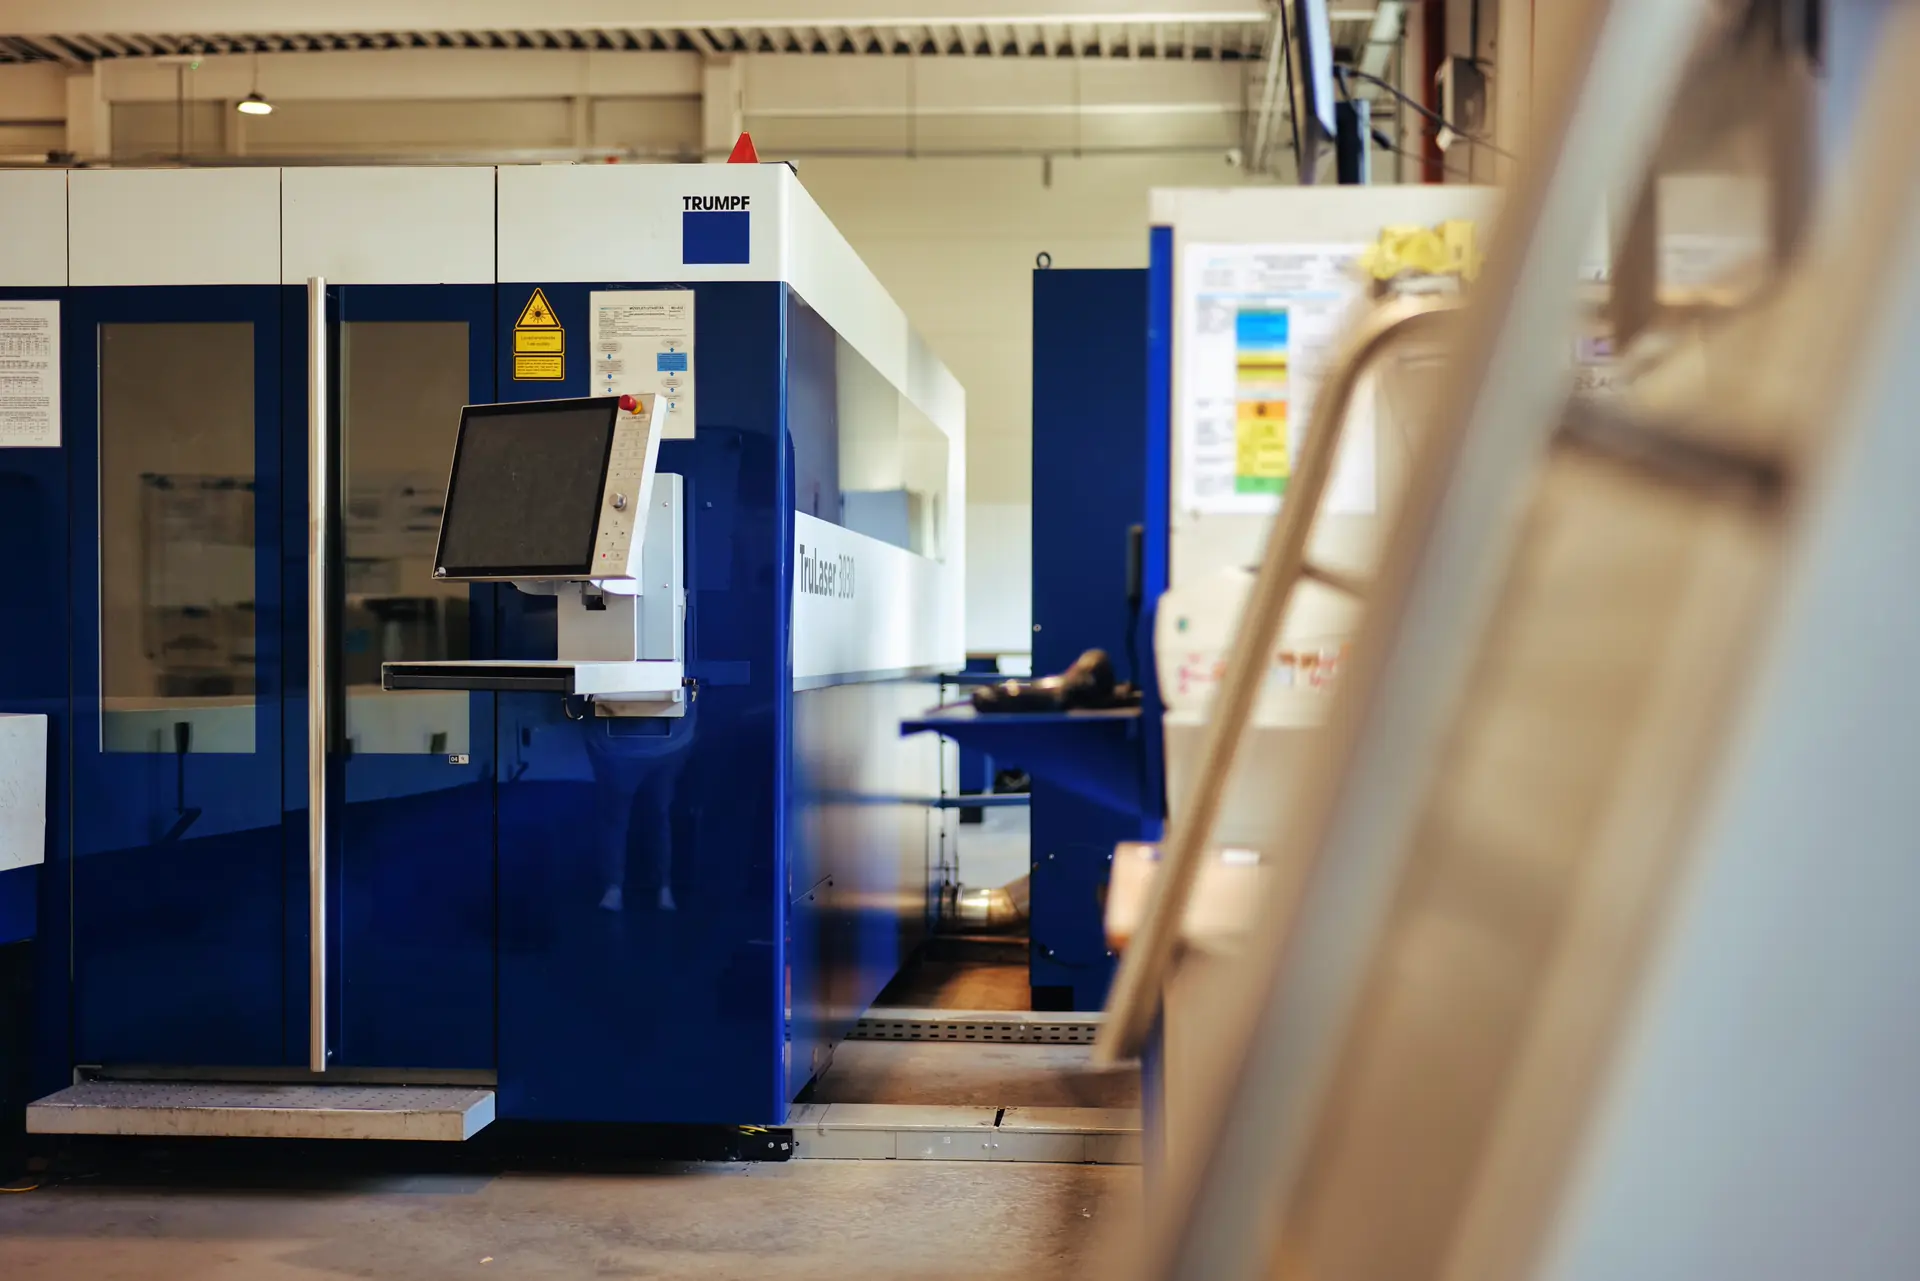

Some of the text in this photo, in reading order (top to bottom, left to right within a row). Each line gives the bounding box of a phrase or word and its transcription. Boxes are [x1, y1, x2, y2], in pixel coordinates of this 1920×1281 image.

[683, 196, 750, 210] TRUMPF
[800, 544, 855, 599] TruLaser 3030
